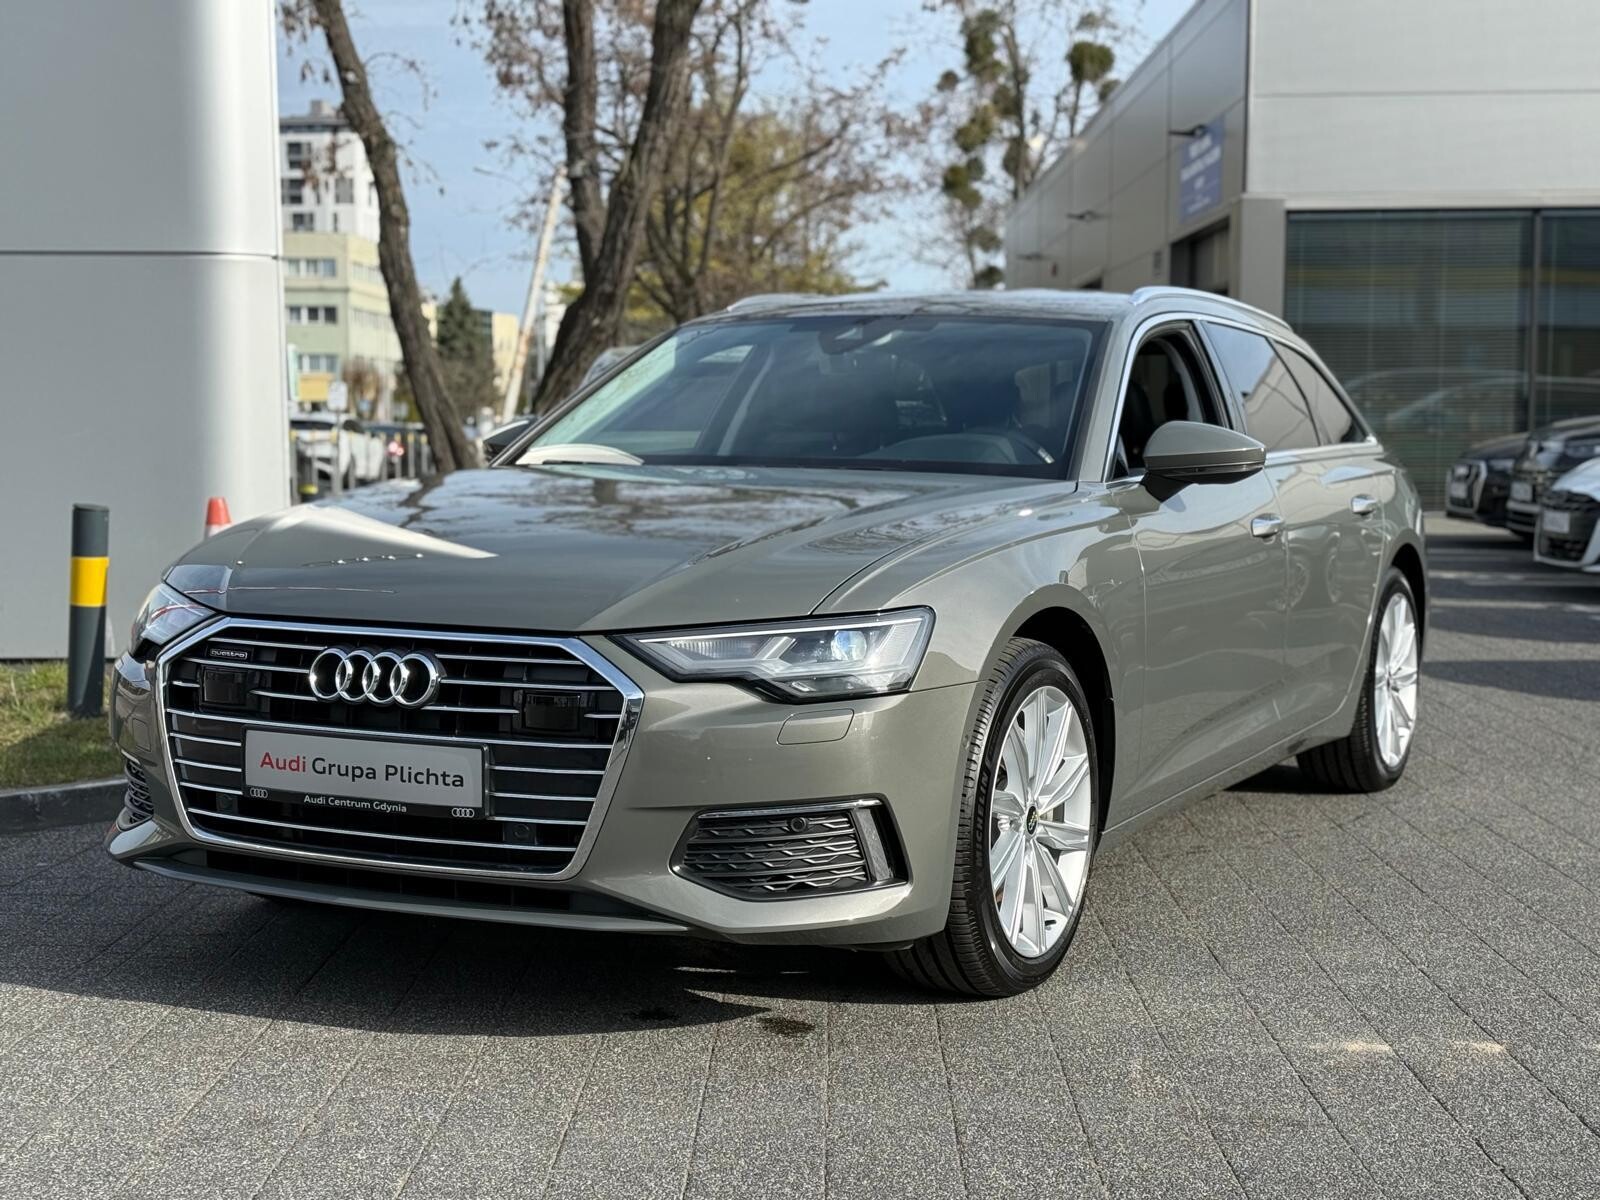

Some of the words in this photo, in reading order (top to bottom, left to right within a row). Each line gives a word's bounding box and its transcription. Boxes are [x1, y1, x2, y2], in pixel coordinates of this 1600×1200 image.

[260, 752, 306, 773] Audi
[312, 757, 377, 783] Grupa
[384, 764, 464, 788] Plichta
[303, 795, 326, 805] Audi
[328, 797, 371, 809] Centrum
[373, 801, 407, 813] Gdynia
[975, 771, 990, 868] MICHELIN
